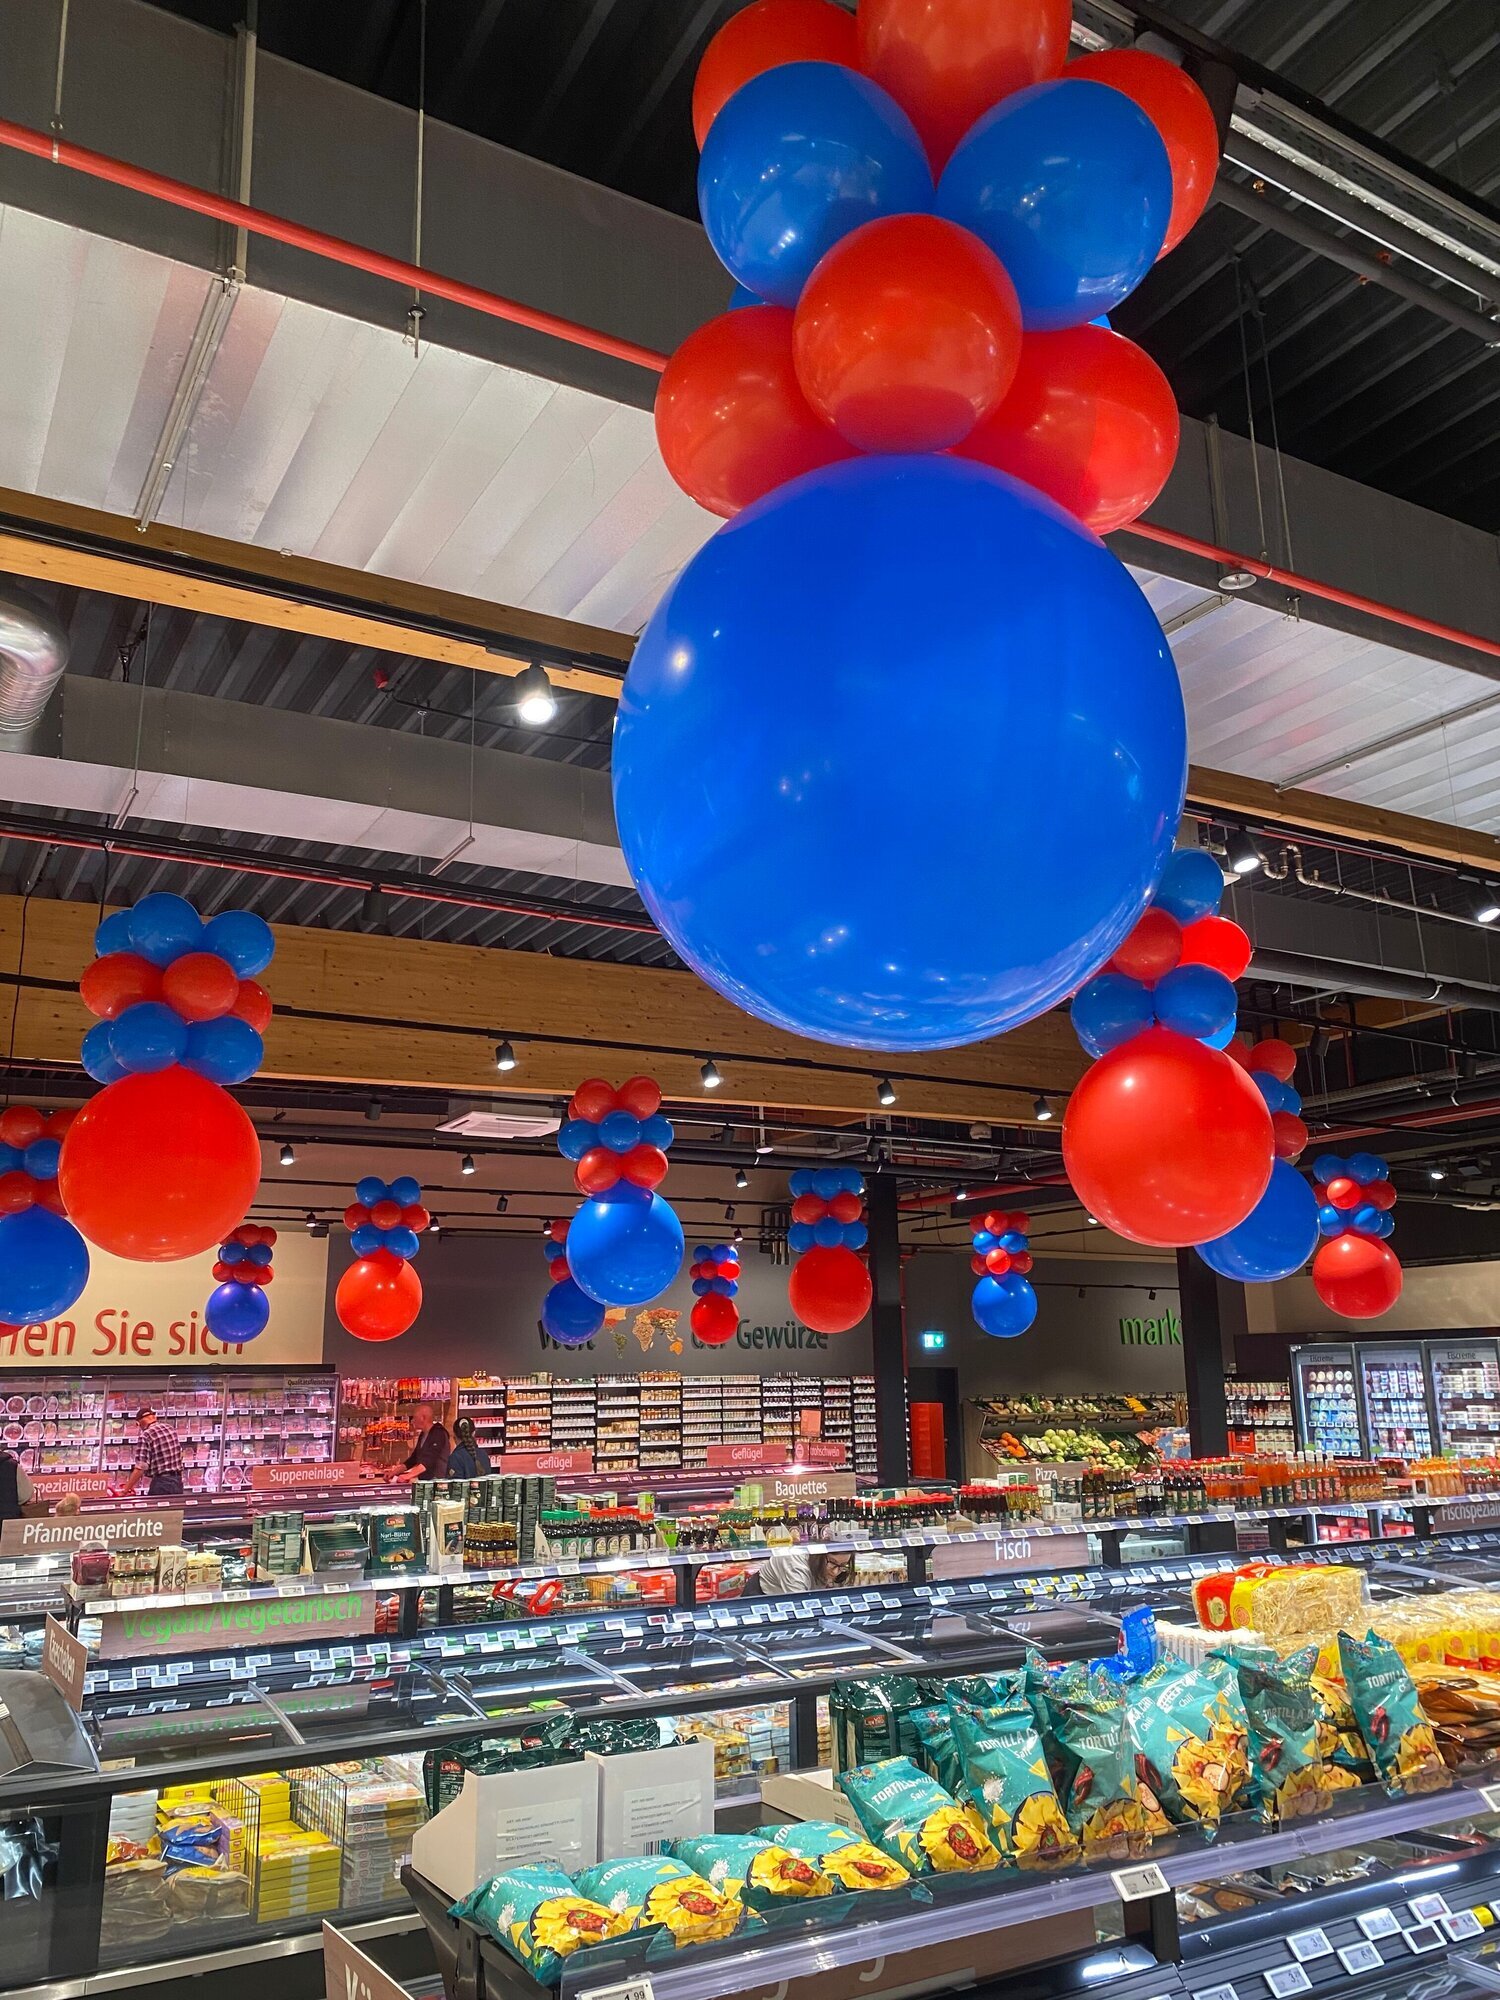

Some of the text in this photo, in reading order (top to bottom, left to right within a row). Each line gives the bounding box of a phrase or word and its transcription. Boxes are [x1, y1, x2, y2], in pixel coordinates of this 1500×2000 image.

[92, 1309, 154, 1357] Sie
[169, 1310, 244, 1356] sic
[736, 1319, 829, 1350] Gewürze
[1119, 1308, 1182, 1345] mark
[536, 1454, 574, 1471] Geflügel
[731, 1446, 764, 1462] Geflügel
[269, 1465, 345, 1484] Suppeneinlage
[1035, 1467, 1058, 1482] Pizza
[775, 1480, 828, 1499] Baguettes
[23, 1517, 163, 1545] Pfannengerichte
[995, 1537, 1031, 1561] Fisch
[910, 1788, 928, 1802] Salt
